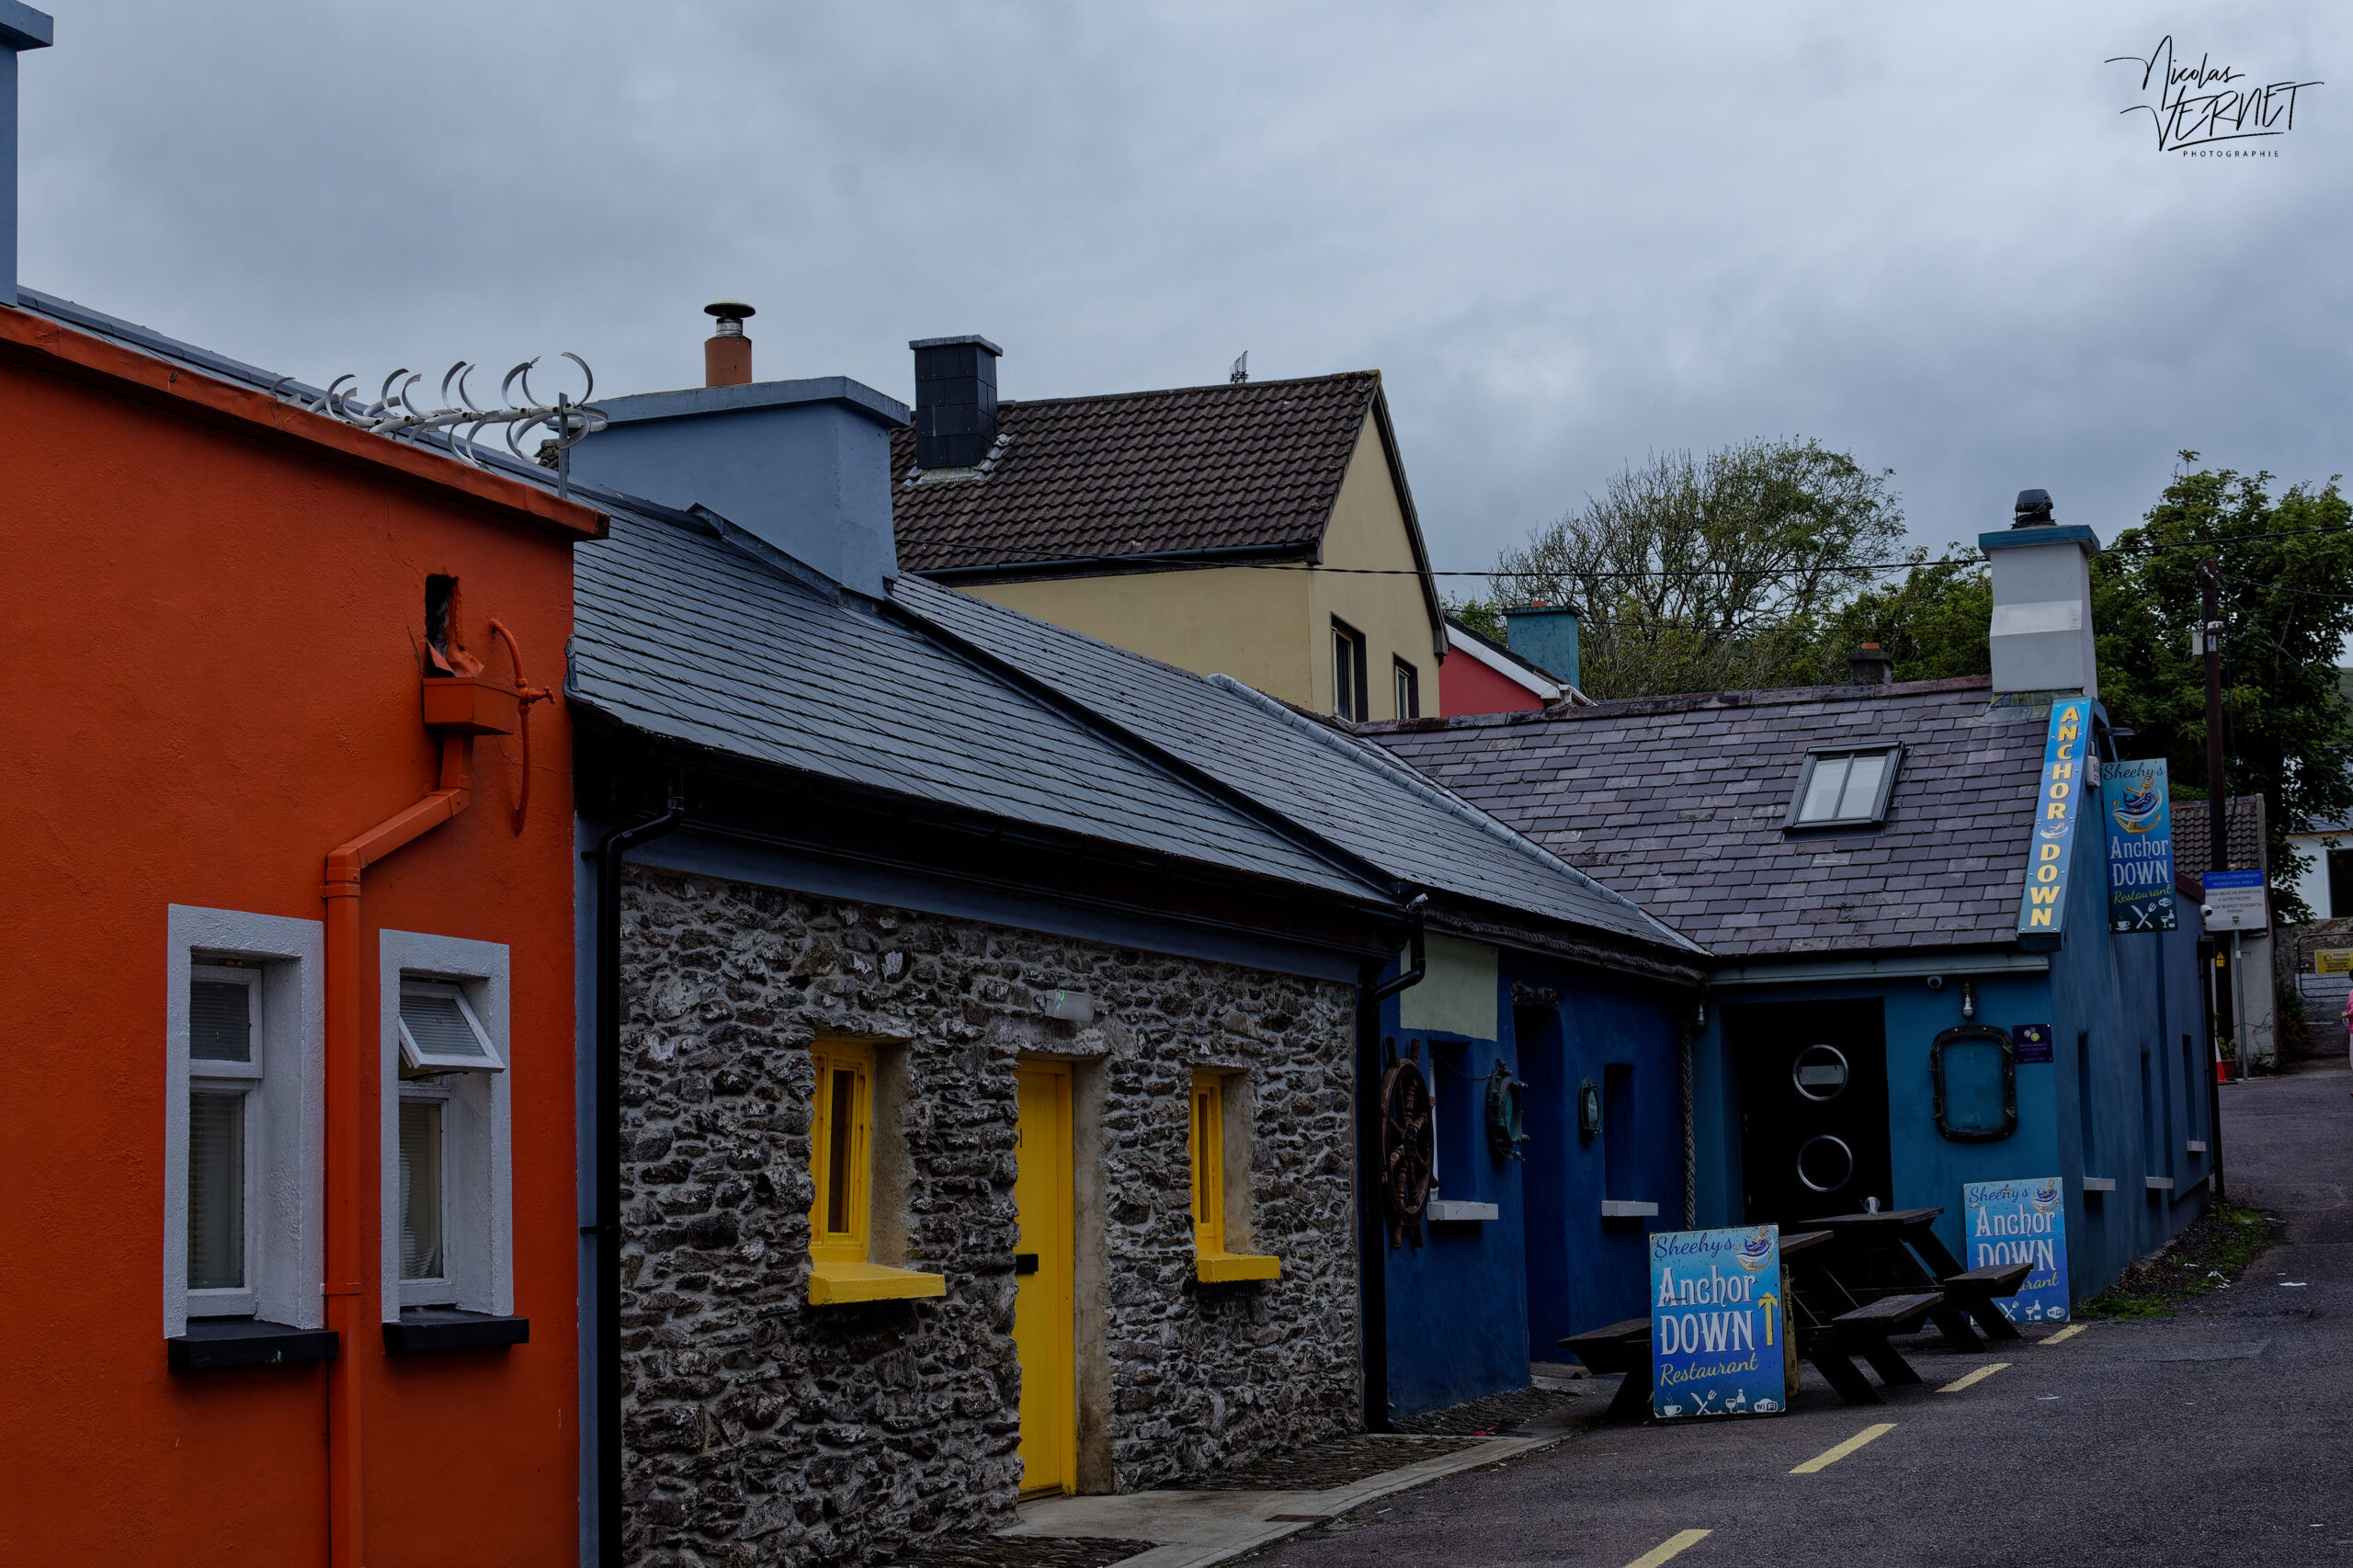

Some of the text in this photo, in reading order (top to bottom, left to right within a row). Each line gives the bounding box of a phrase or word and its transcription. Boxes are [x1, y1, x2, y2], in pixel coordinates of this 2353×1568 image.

[2103, 760, 2164, 780] Sheehy's
[2029, 706, 2080, 926] ANCHOR DOWN
[2110, 835, 2169, 859] Anchor
[2111, 859, 2170, 887] DOWN
[2114, 884, 2172, 904] Restaurant
[1975, 1204, 2056, 1237] Anchor
[1654, 1231, 1735, 1258] Sheehy's
[1977, 1238, 2056, 1272] DOWN
[1656, 1265, 1758, 1308] Anchor
[1660, 1310, 1756, 1356] DOWN
[1660, 1353, 1759, 1386] Restaurant
